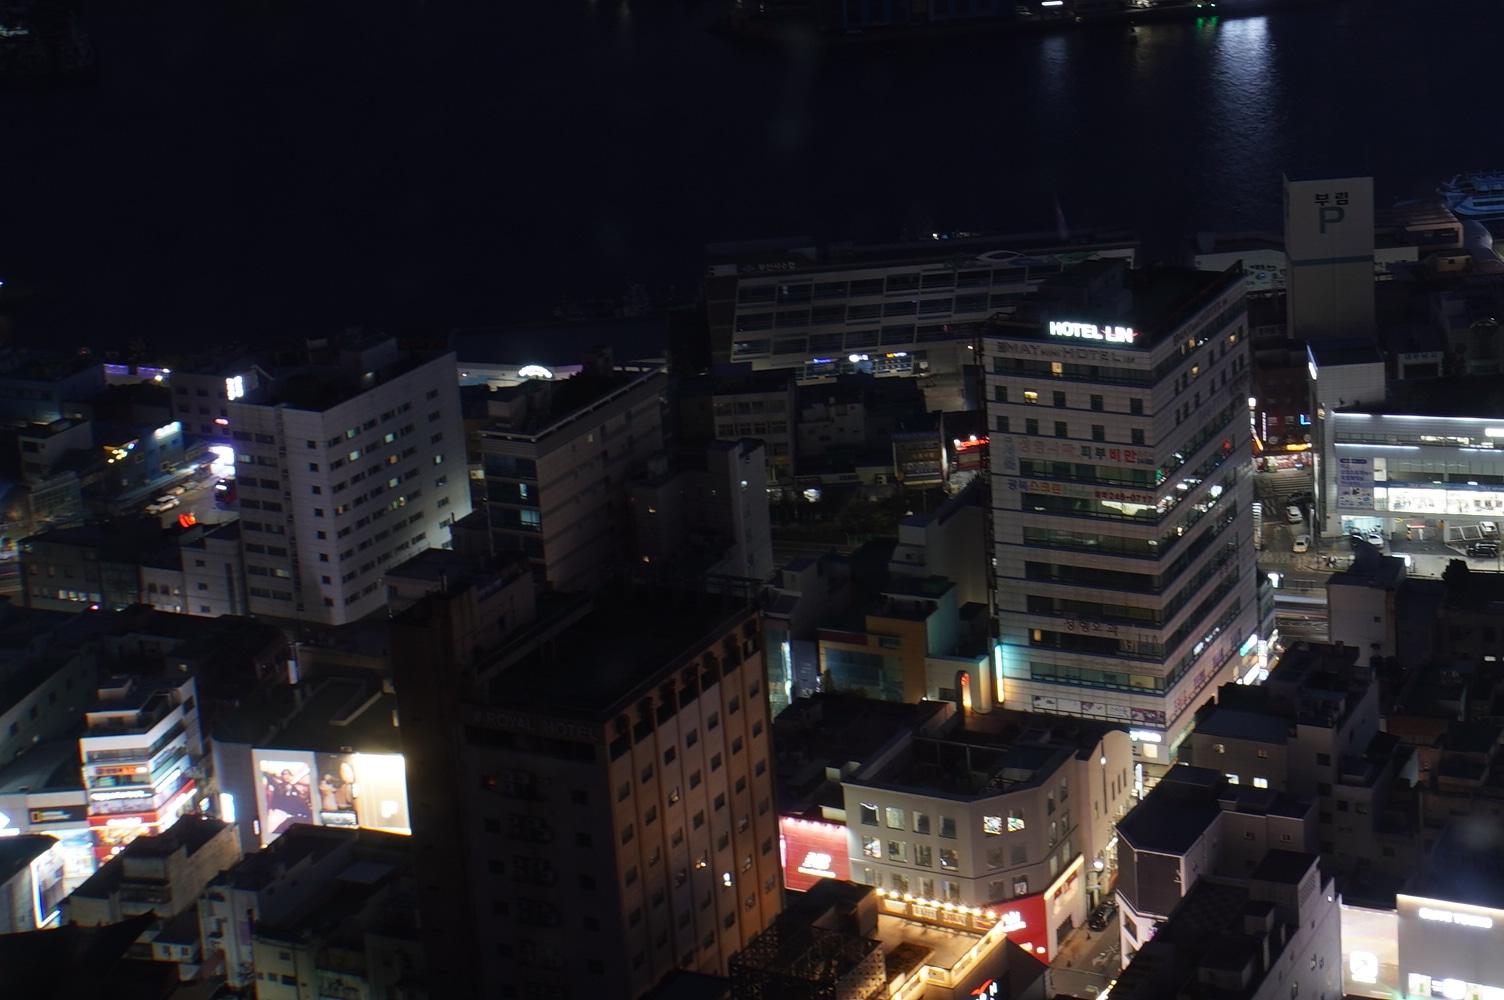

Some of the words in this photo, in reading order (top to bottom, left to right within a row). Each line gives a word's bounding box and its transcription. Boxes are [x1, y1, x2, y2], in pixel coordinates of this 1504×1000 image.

[1315, 191, 1348, 206] 부림
[1318, 206, 1345, 233] P
[1049, 320, 1103, 340] HOTEL
[1104, 325, 1134, 344] LIN
[1062, 347, 1122, 363] HOTEL
[1081, 445, 1106, 460] 피부
[1108, 448, 1137, 464] 비만
[487, 712, 534, 731] ROYAL
[543, 719, 599, 741] HOTEL
